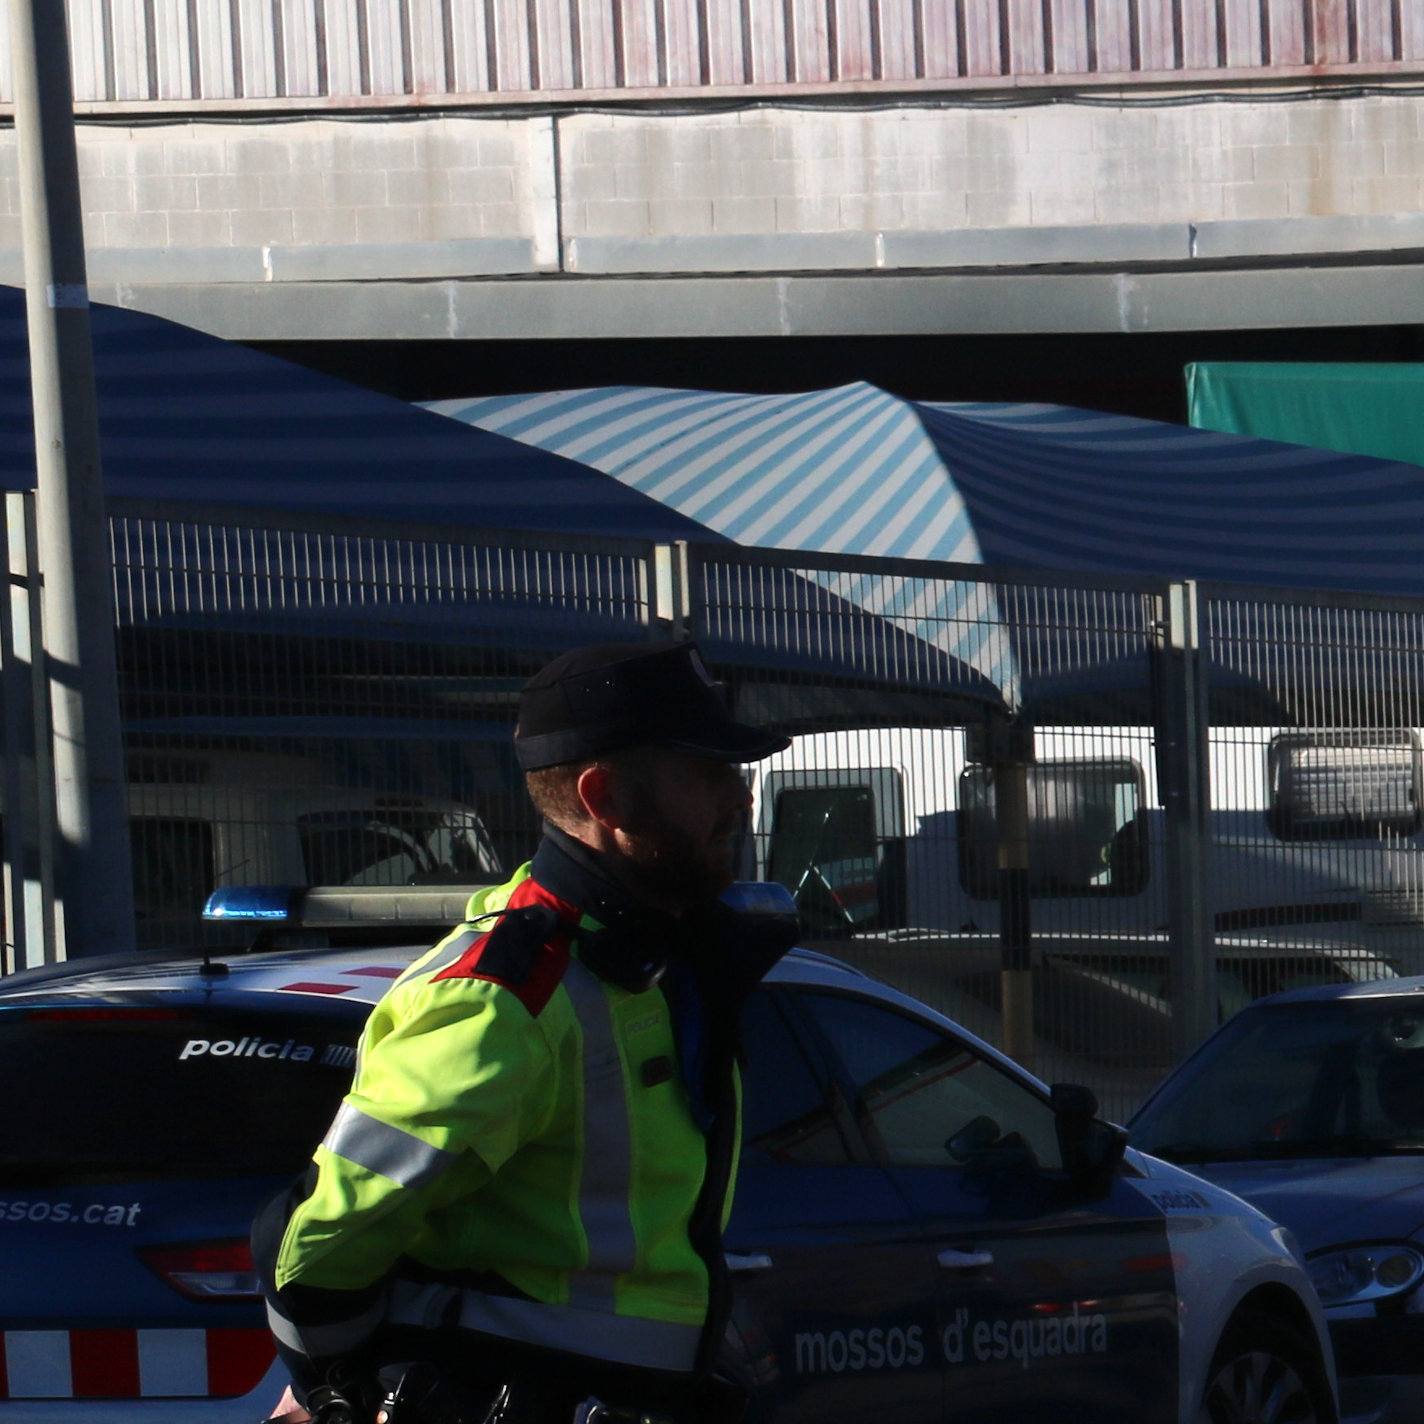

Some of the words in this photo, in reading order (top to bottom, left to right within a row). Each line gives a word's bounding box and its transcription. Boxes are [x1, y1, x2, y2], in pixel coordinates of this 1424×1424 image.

[178, 1035, 317, 1064] policia
[794, 1324, 925, 1375] mossos
[941, 1301, 1108, 1369] d'esquadra
